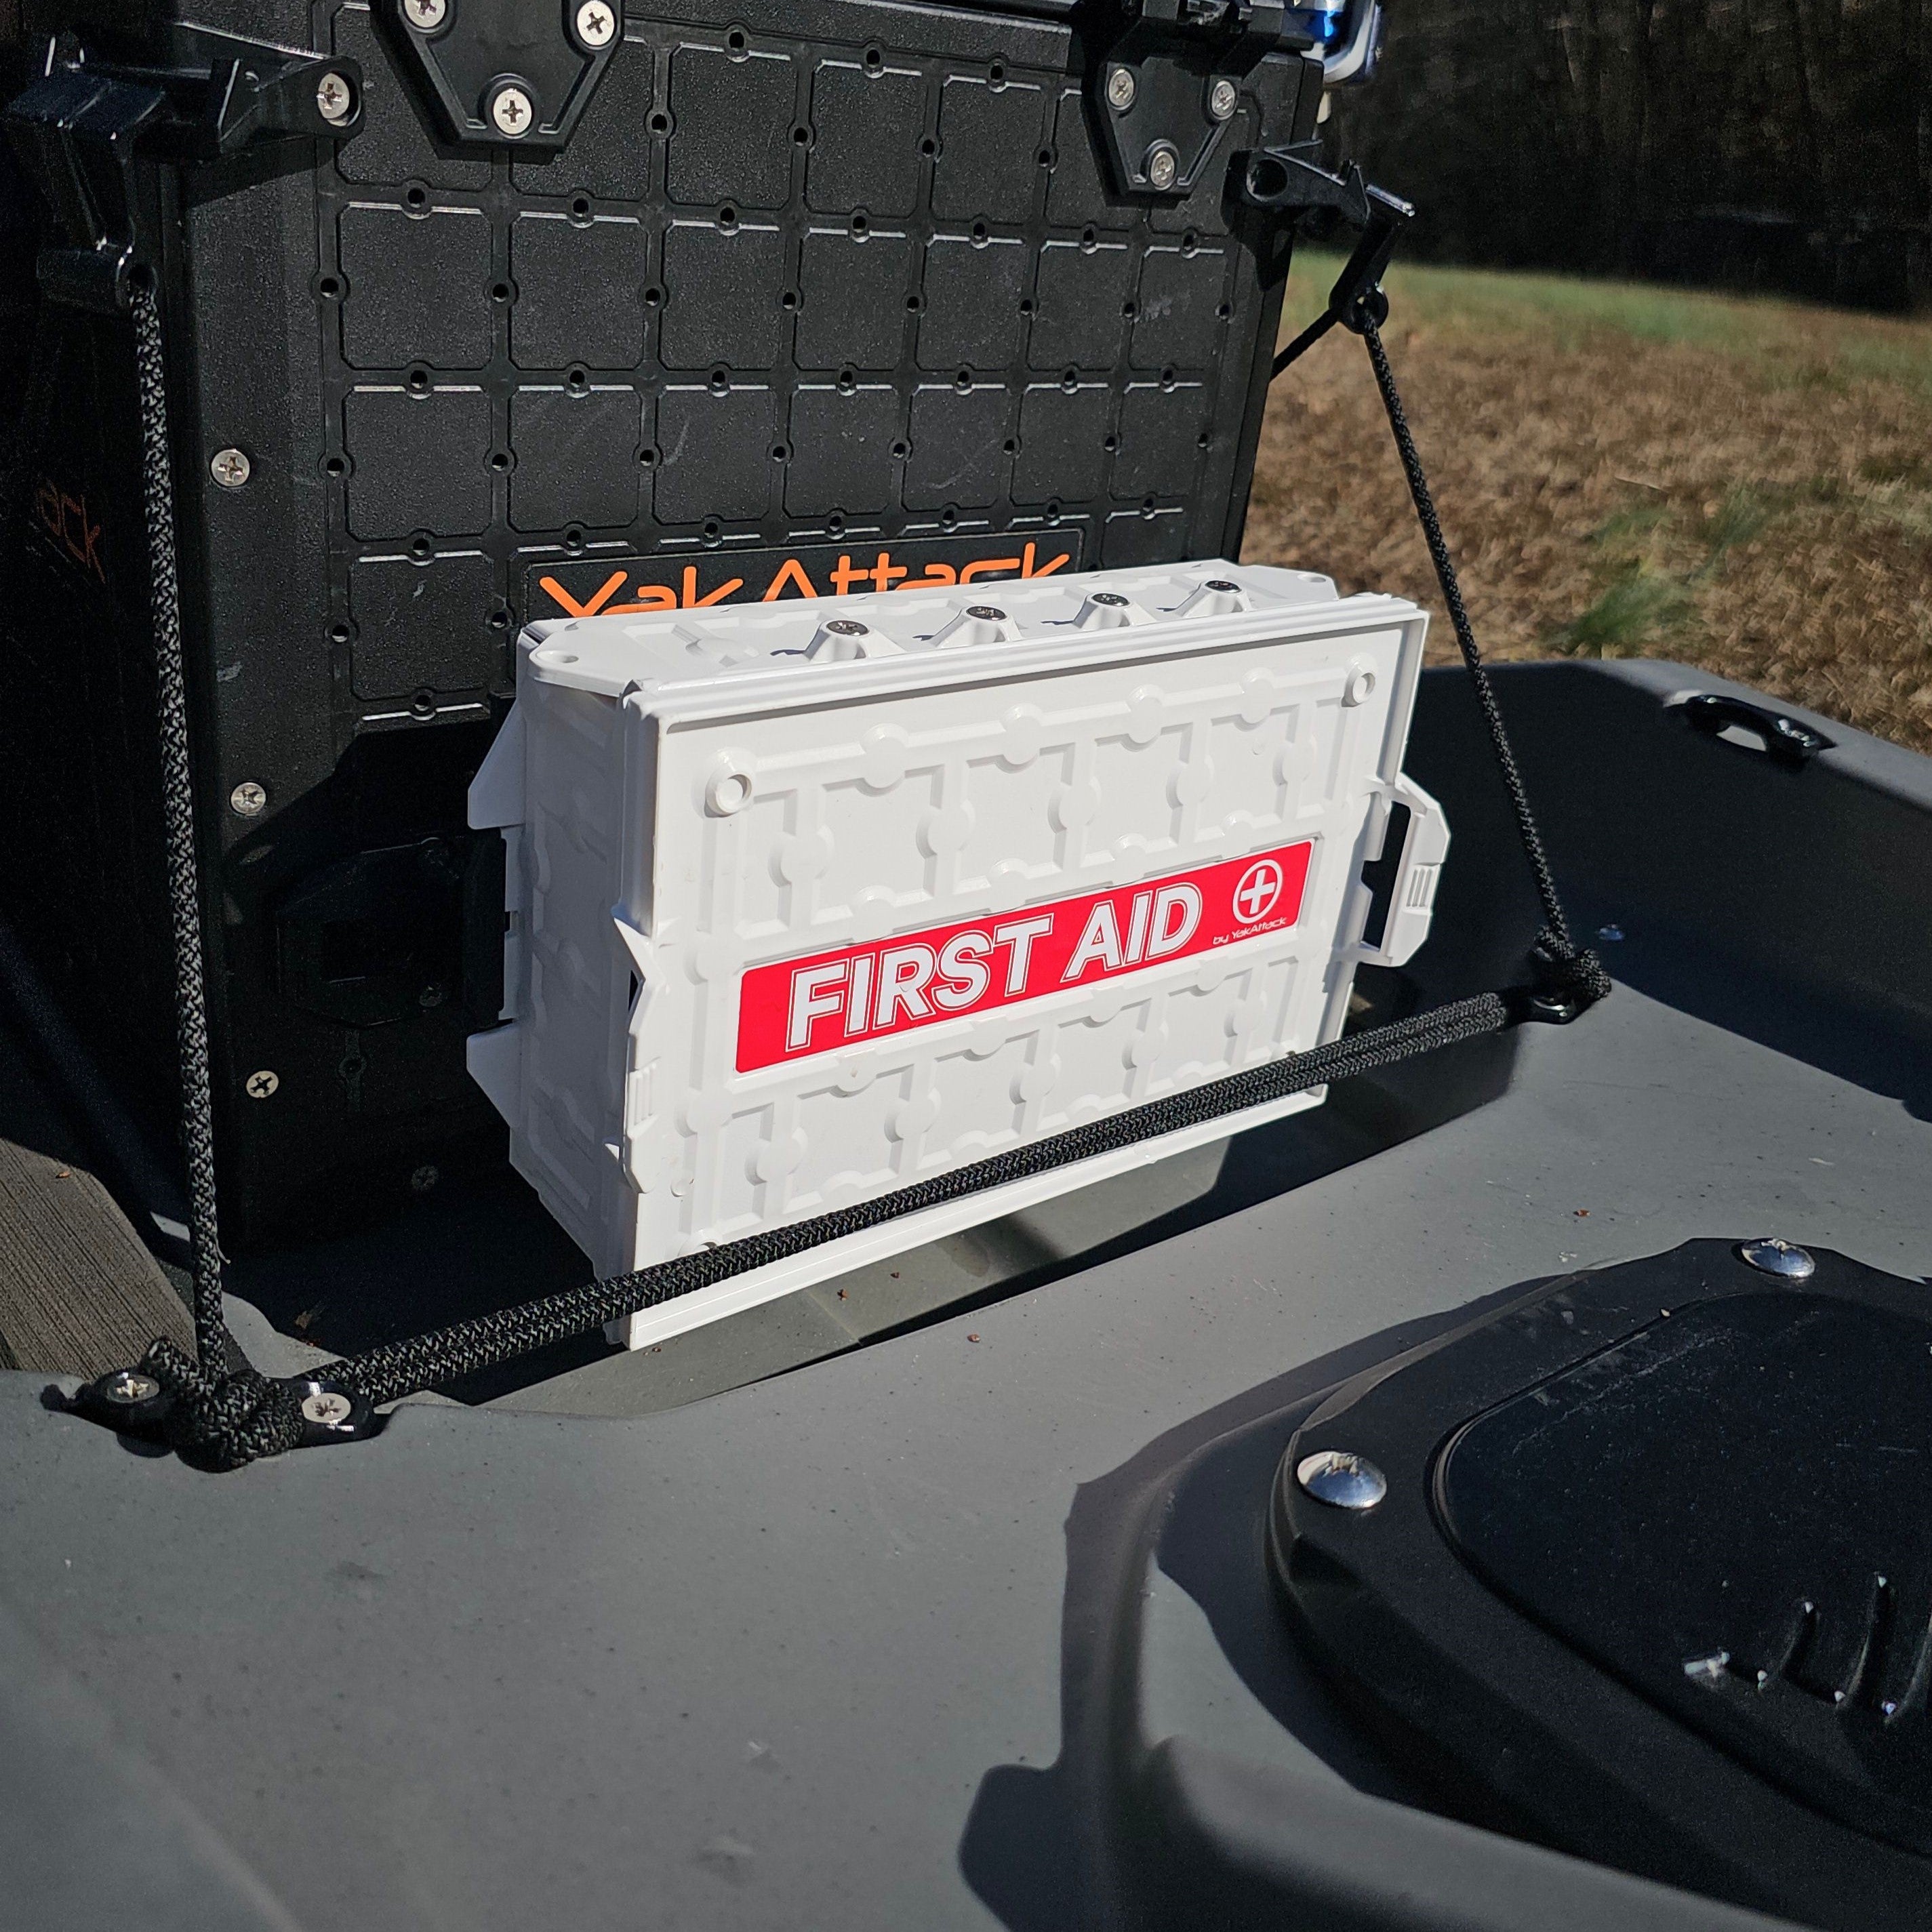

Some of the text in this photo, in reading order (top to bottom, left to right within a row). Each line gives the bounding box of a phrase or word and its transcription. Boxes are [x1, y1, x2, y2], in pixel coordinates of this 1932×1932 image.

[786, 883, 1203, 1052] FIRST AID
[1213, 917, 1287, 945] by YakAttack
